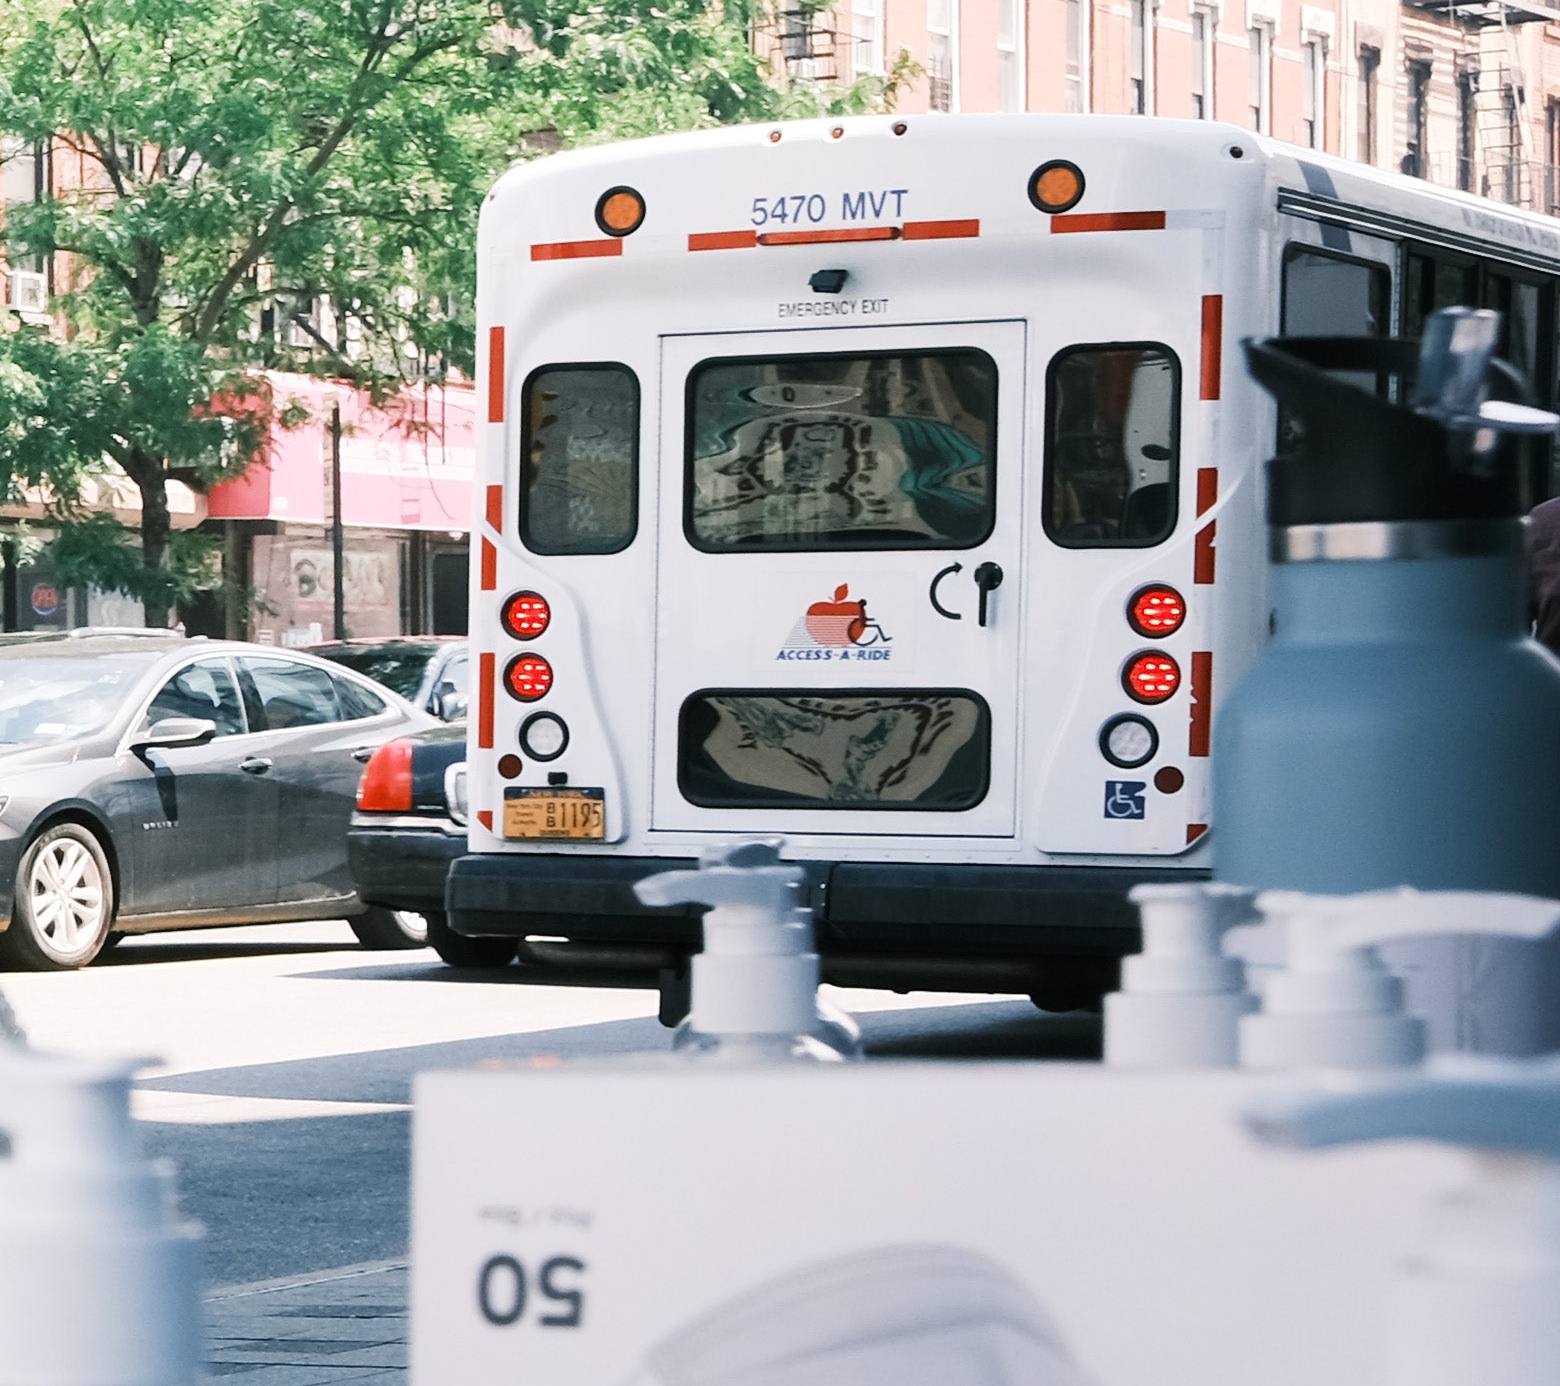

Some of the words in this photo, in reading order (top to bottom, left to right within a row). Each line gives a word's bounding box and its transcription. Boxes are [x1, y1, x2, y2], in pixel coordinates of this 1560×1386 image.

[751, 194, 826, 226] 5470
[842, 189, 909, 221] MVT
[778, 300, 857, 318] EMERGENCY
[861, 298, 889, 314] EXIT
[776, 649, 892, 661] ACCESS-A-RIDE
[479, 1253, 585, 1327] 50
